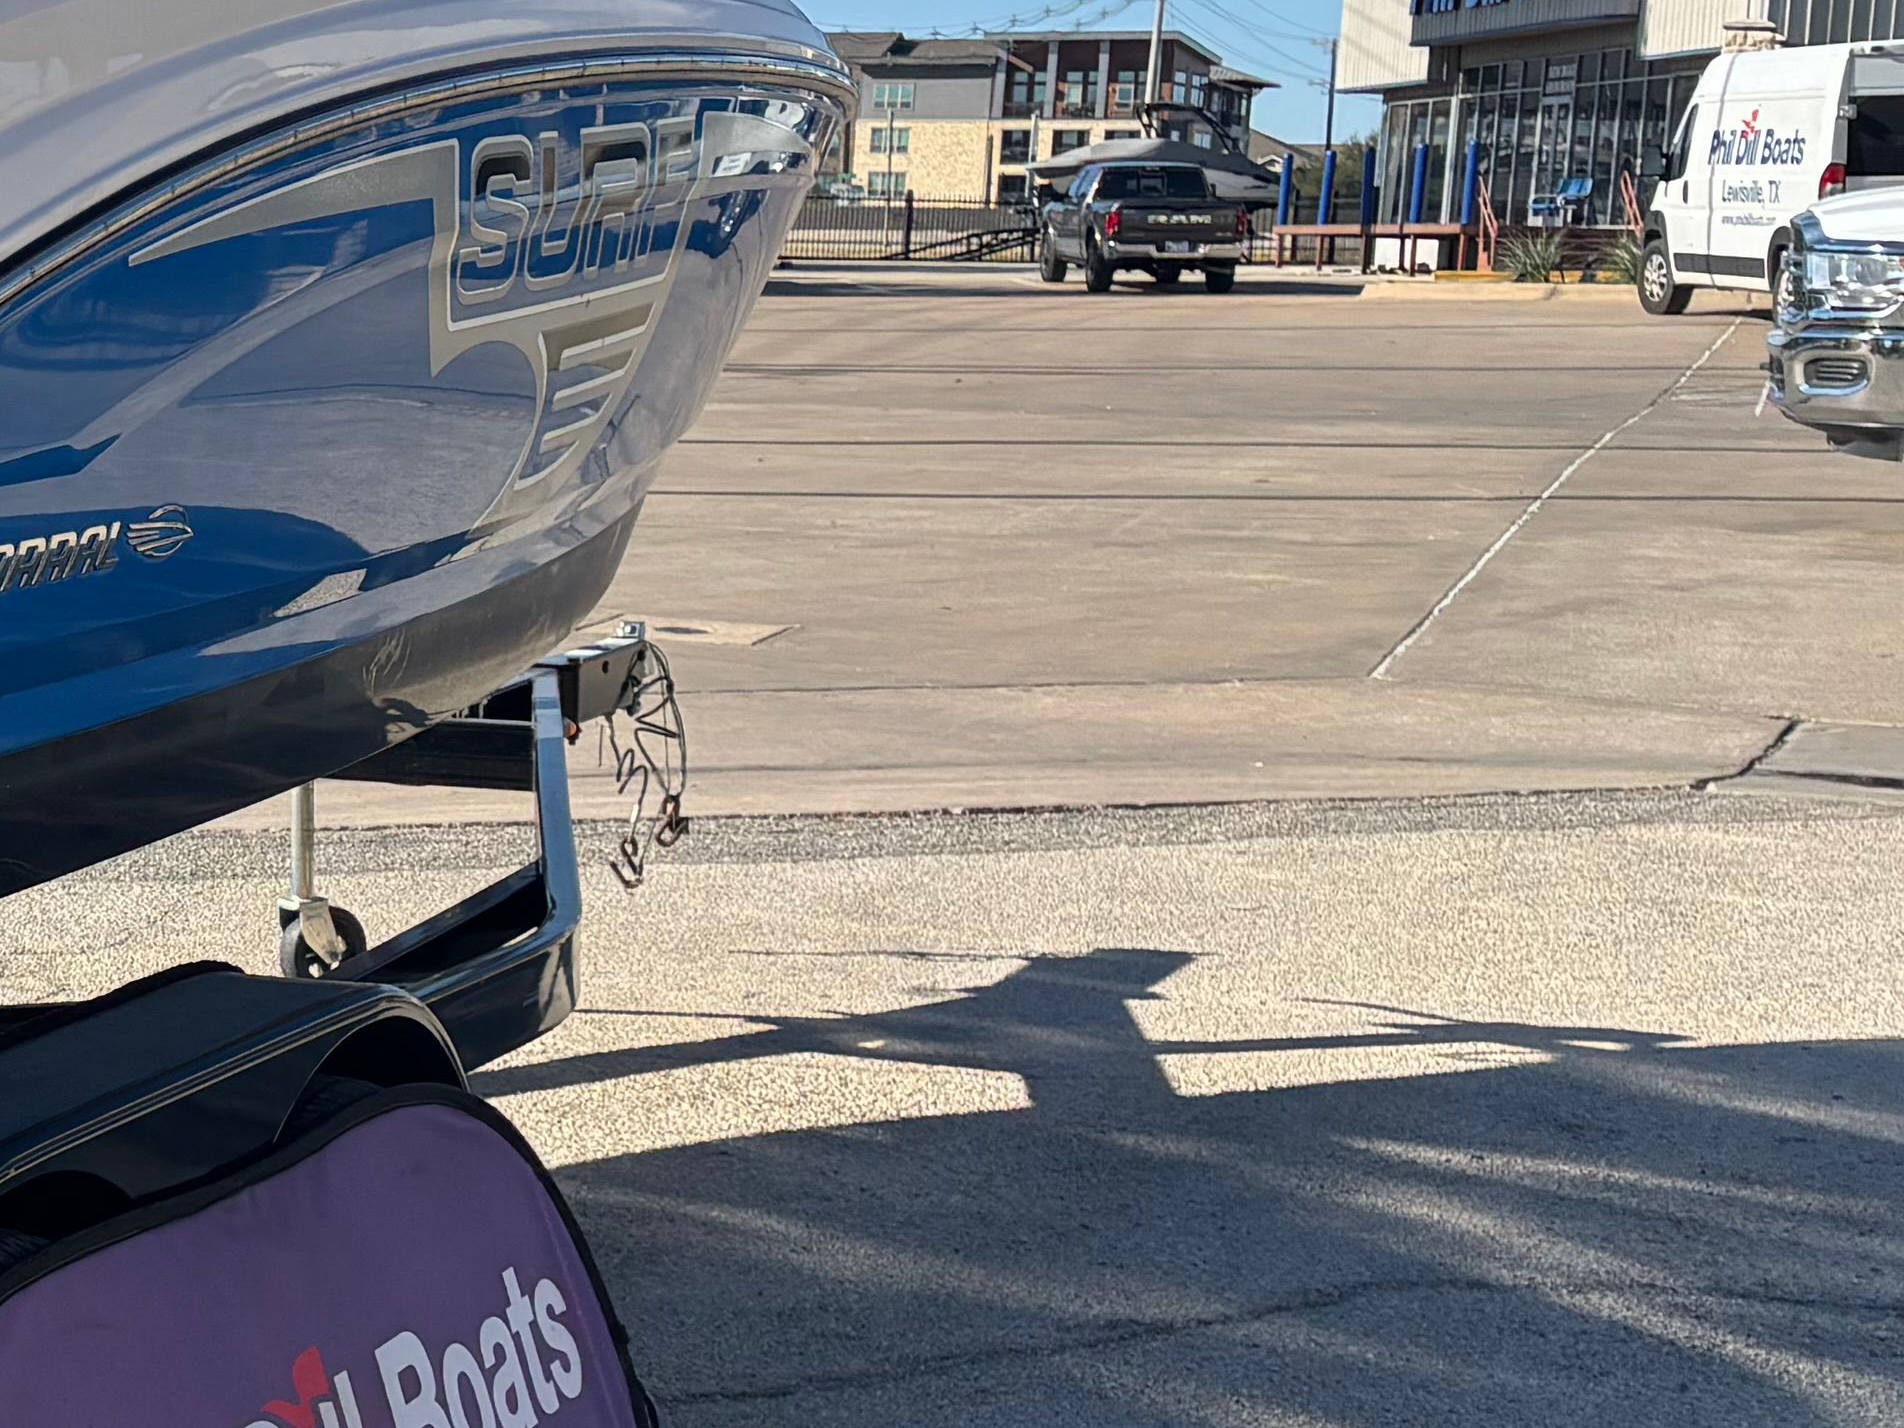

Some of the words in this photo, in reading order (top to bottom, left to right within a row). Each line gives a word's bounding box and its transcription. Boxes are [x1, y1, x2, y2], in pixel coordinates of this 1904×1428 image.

[1707, 129, 1738, 165] Phil
[1735, 129, 1762, 165] Dill
[1760, 128, 1806, 165] Boats
[1768, 179, 1782, 203] TX
[456, 115, 696, 306] SURF
[1147, 214, 1212, 225] RAM
